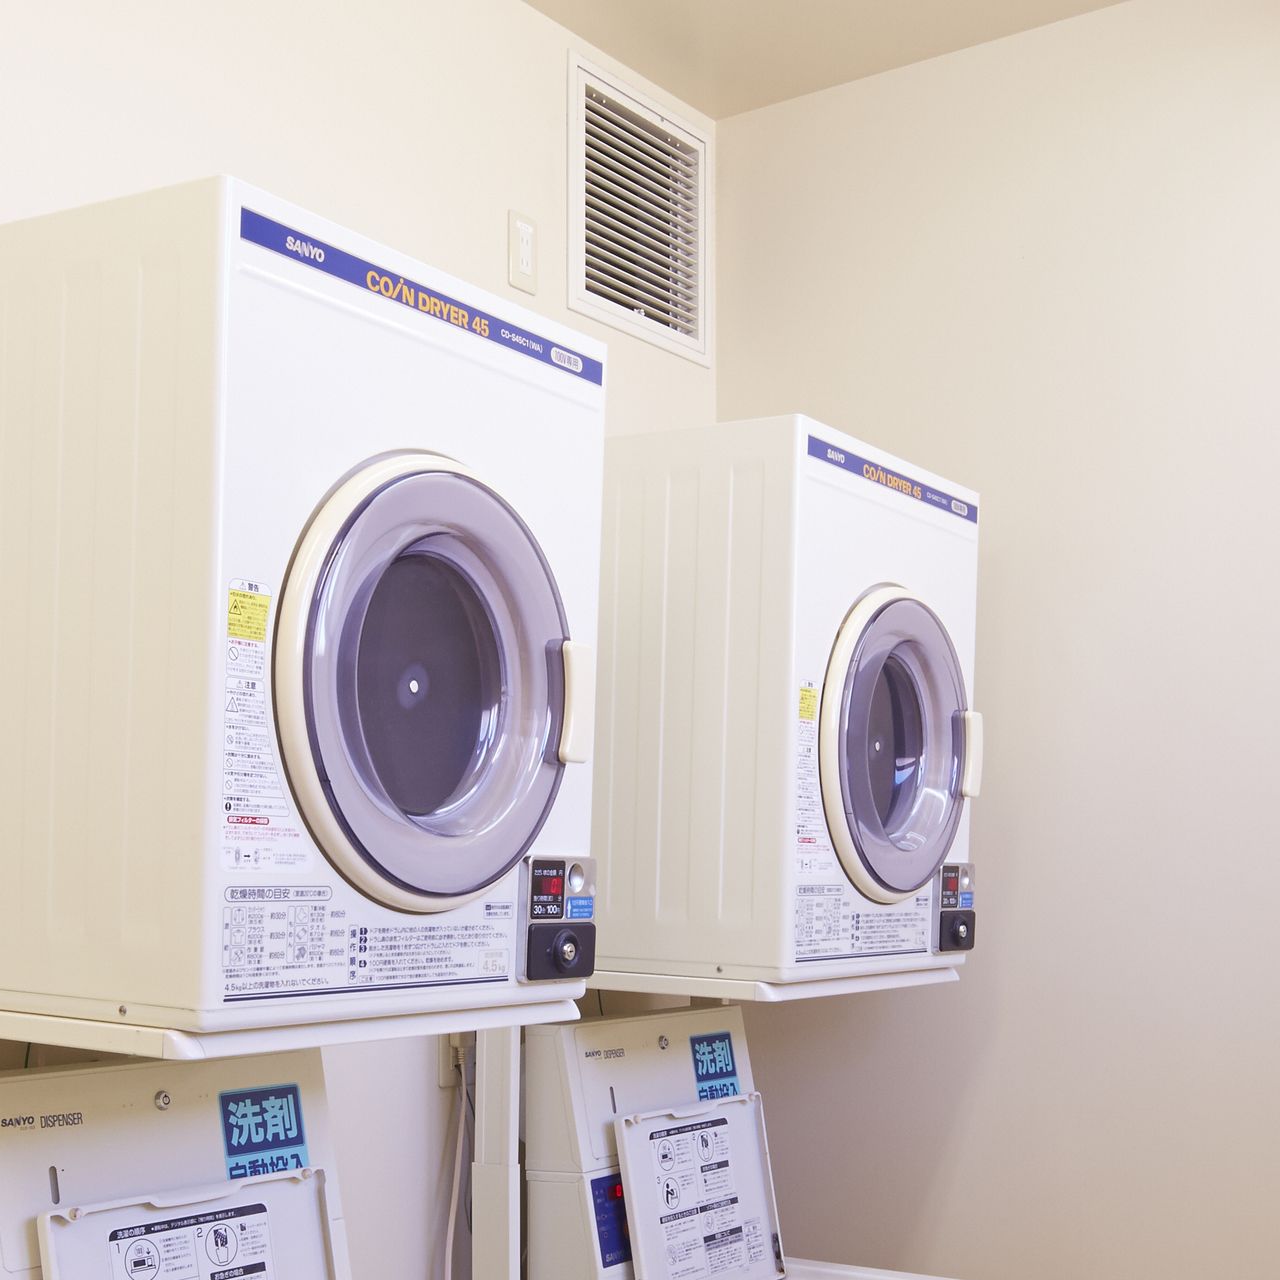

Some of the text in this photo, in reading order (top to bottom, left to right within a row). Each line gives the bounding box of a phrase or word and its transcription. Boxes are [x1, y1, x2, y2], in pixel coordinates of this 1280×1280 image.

[285, 235, 326, 263] SANYO
[418, 291, 469, 329] DRYER
[472, 316, 490, 337] 45
[826, 448, 846, 464] SANYO
[887, 474, 912, 496] DRYER
[912, 486, 922, 500] 45
[244, 681, 257, 690] 注意
[230, 888, 291, 900] 乾燥時間の目安
[482, 959, 506, 973] 4.5kg
[695, 1039, 734, 1076] 洗剤
[0, 1112, 84, 1129] SANYO DISPENSER
[227, 1093, 298, 1147] 洗剤
[117, 1226, 146, 1239] 洗濯の順序
[196, 1227, 203, 1238] 2
